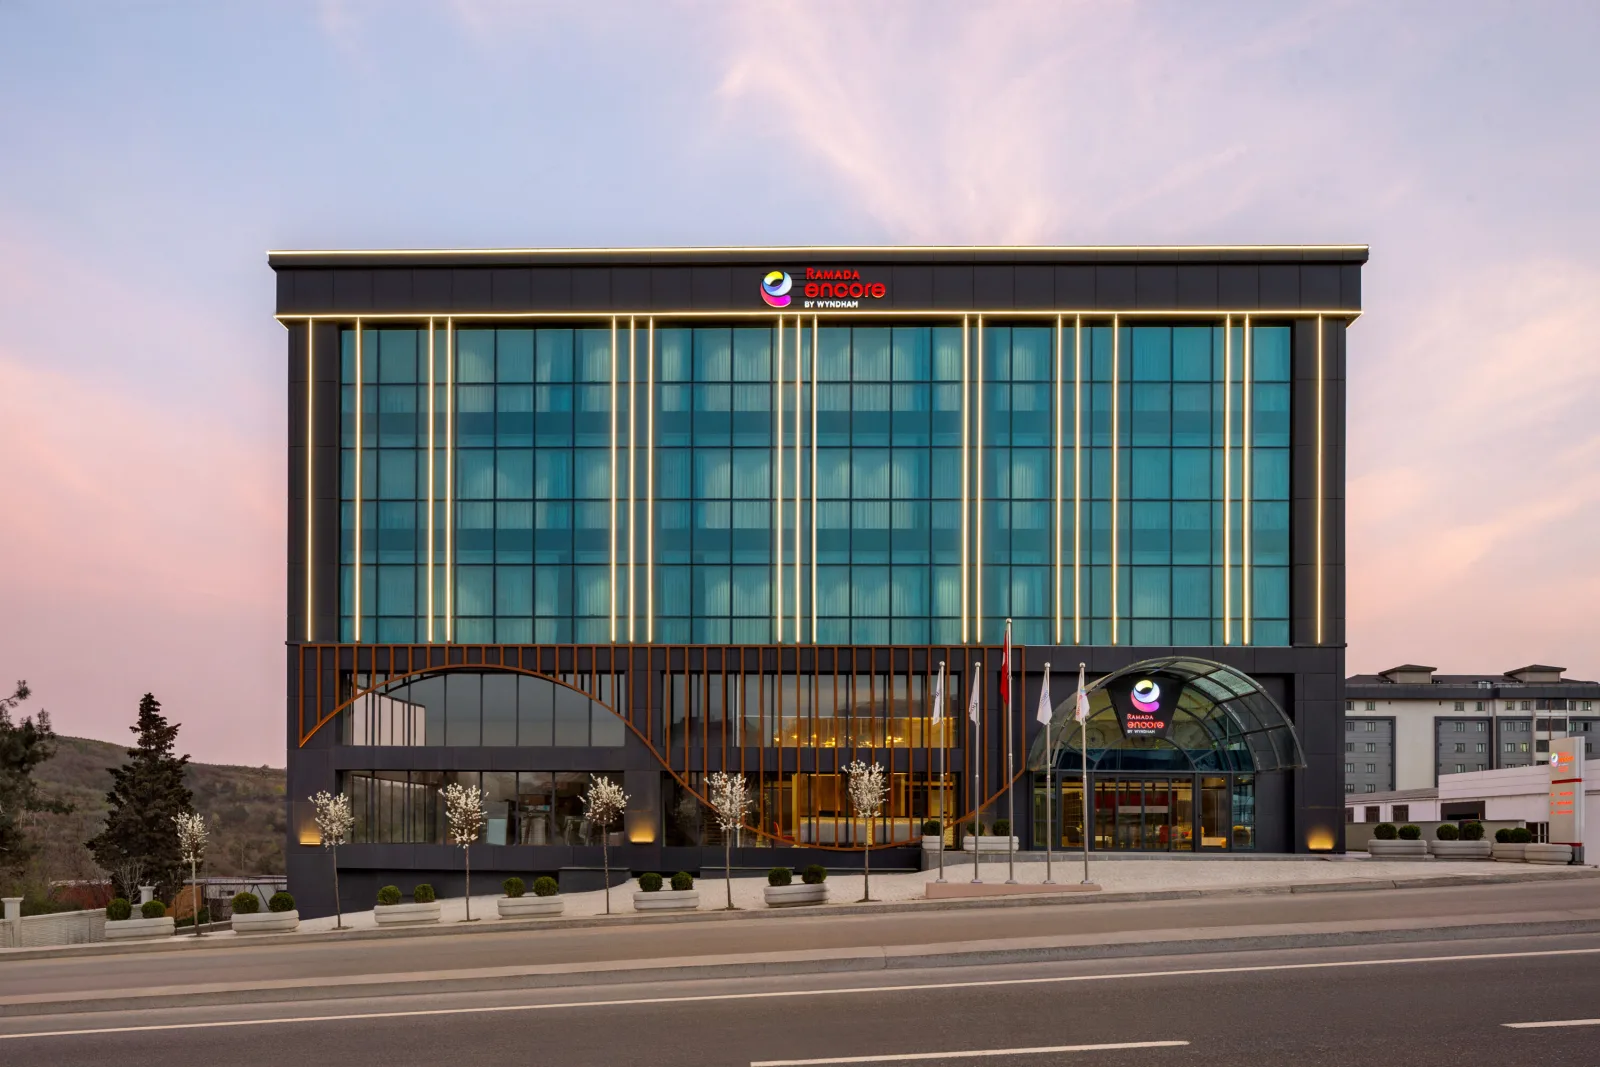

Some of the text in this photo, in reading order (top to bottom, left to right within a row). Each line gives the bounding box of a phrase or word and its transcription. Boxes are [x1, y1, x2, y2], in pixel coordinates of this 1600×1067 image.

[806, 267, 861, 279] RAMADA
[804, 282, 886, 298] encore
[1127, 721, 1164, 729] encore
